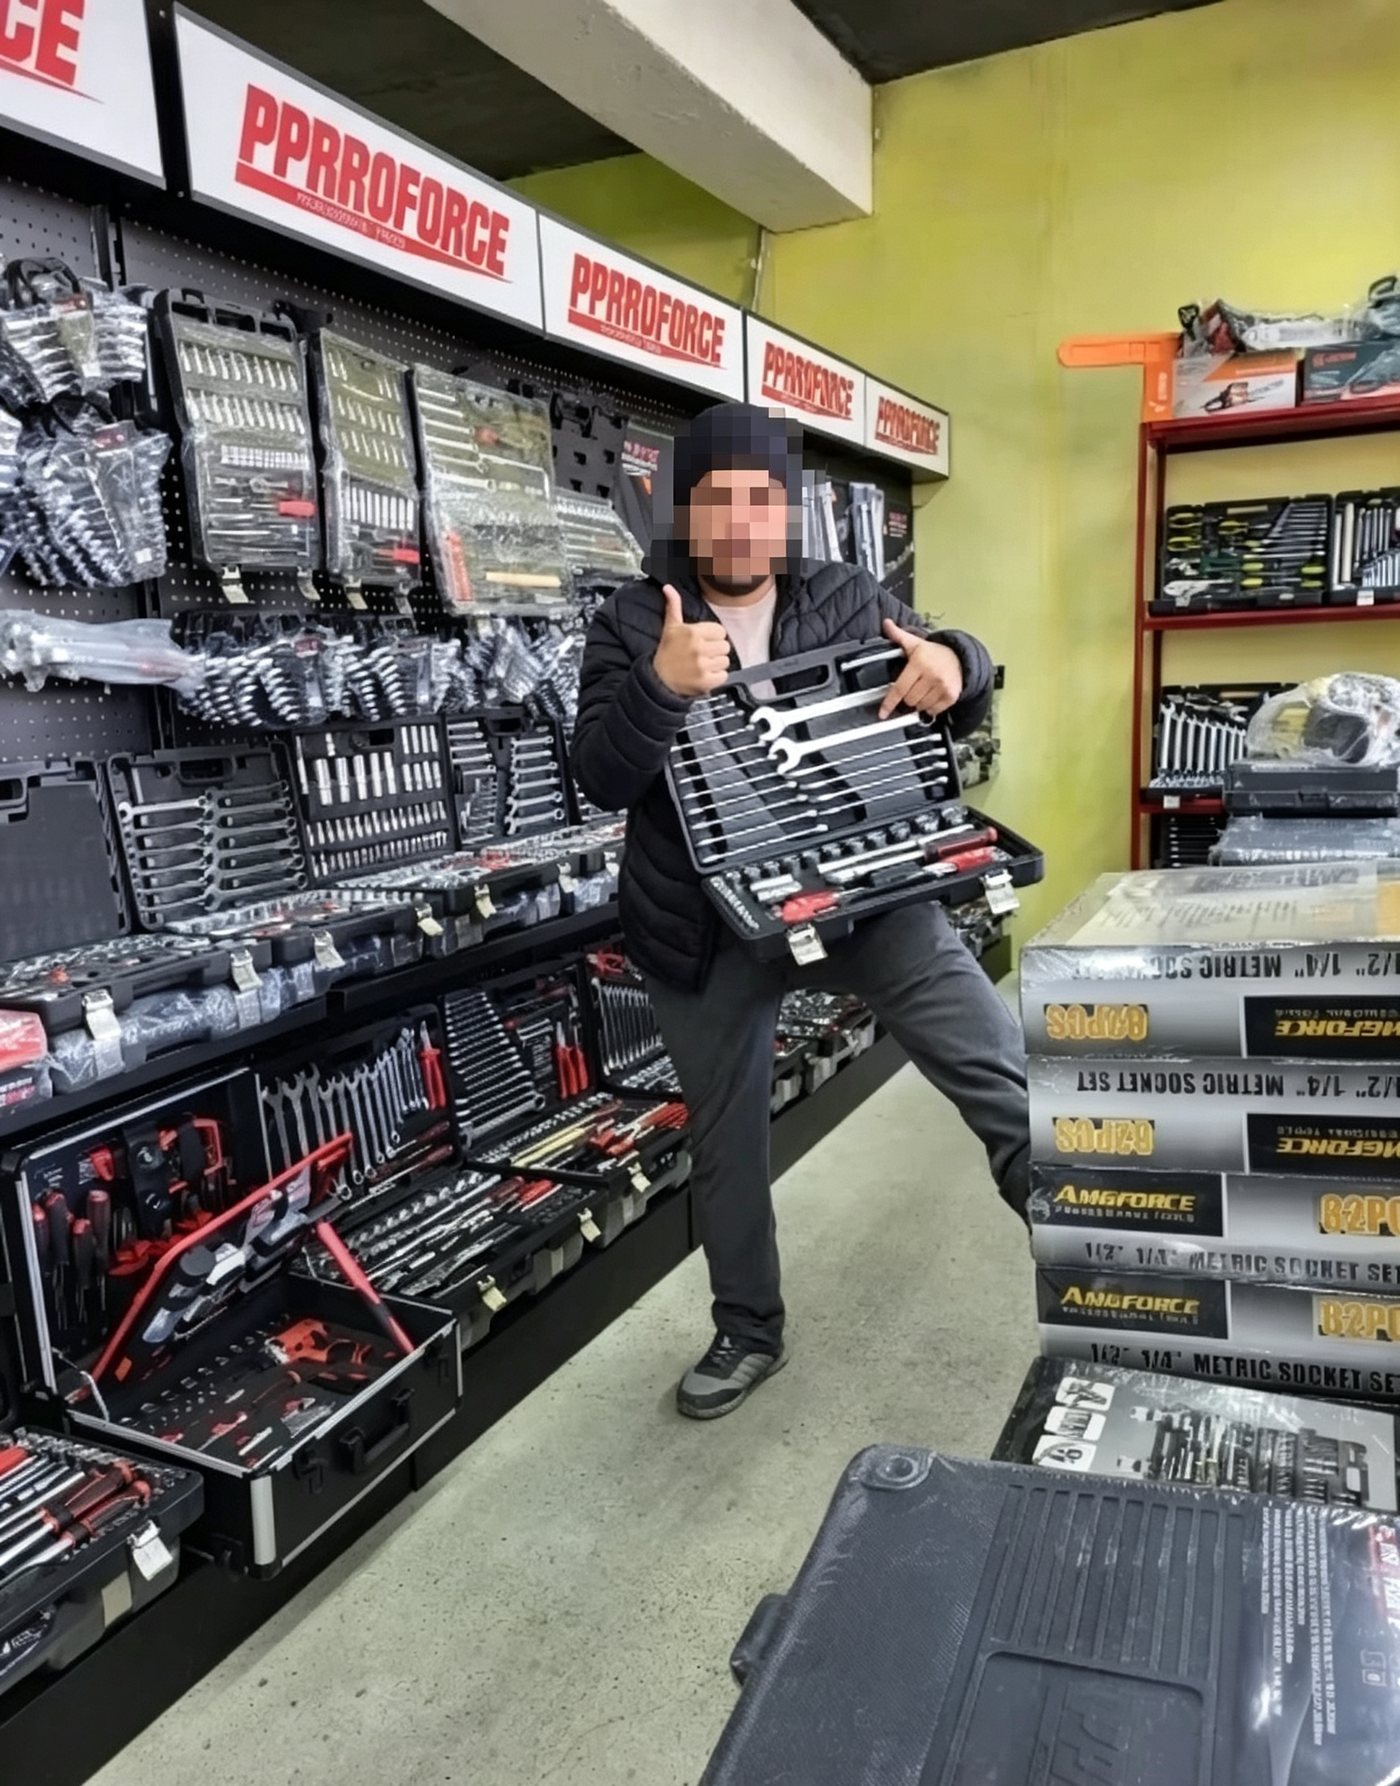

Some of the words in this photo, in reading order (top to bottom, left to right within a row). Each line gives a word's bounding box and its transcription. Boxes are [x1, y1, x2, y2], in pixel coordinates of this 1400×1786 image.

[239, 83, 511, 277] PPRROFORCE
[570, 253, 725, 363] PPRROFORCE
[1200, 954, 1281, 978] METRIC
[1077, 1071, 1111, 1092] SET
[1117, 1072, 1196, 1095] SOCKET
[1203, 1073, 1284, 1096] METRIC
[1053, 1184, 1196, 1212] AMGFORCE
[1194, 1353, 1271, 1380] METRIC
[1278, 1361, 1361, 1390] SOCKET
